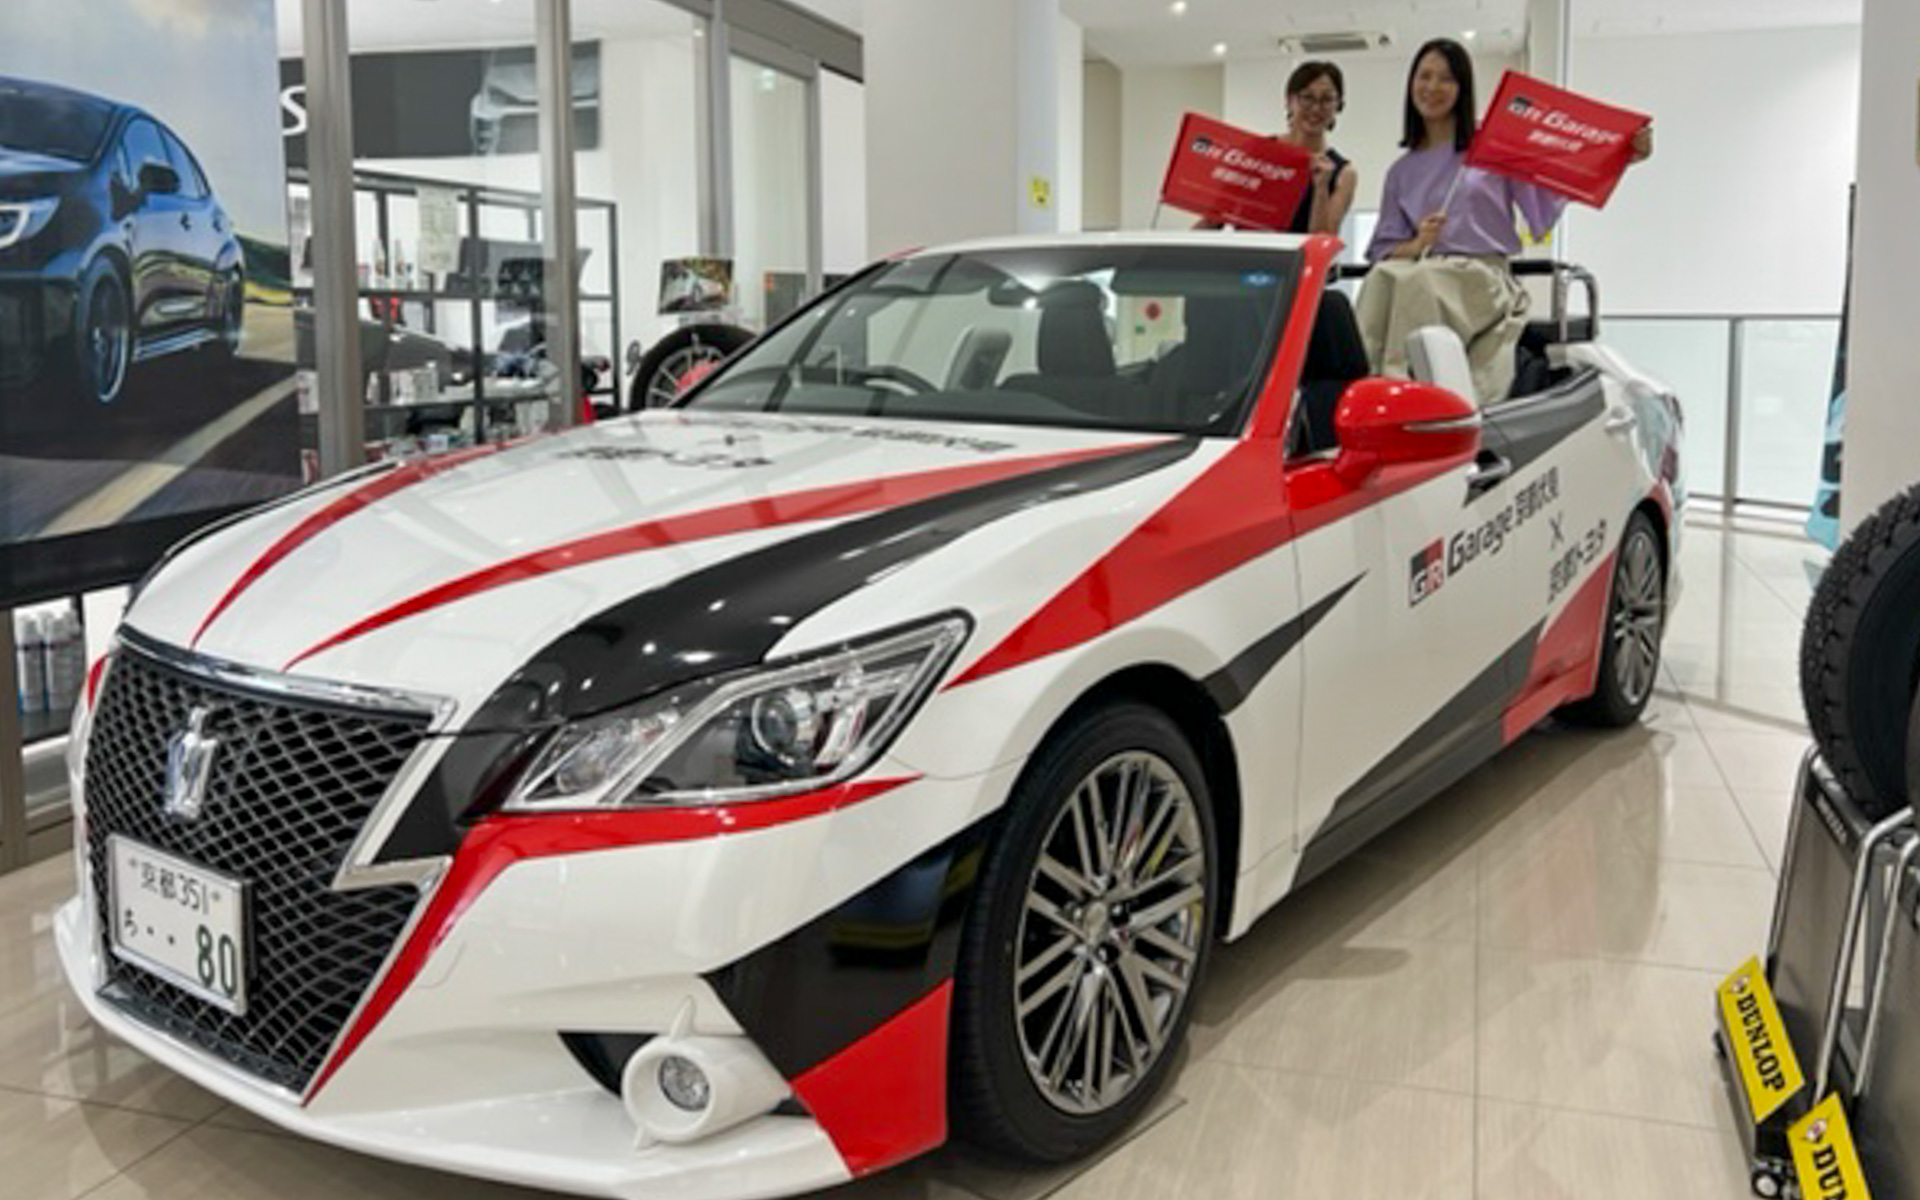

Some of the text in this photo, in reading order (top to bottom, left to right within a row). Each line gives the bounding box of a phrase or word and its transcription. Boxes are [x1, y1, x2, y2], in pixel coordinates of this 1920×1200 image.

[1223, 148, 1297, 180] Garage
[1542, 111, 1624, 143] Garage
[1411, 549, 1444, 606] GR
[1447, 505, 1513, 577] Garage
[196, 923, 237, 999] 80
[1736, 993, 1786, 1092] DUNLOP
